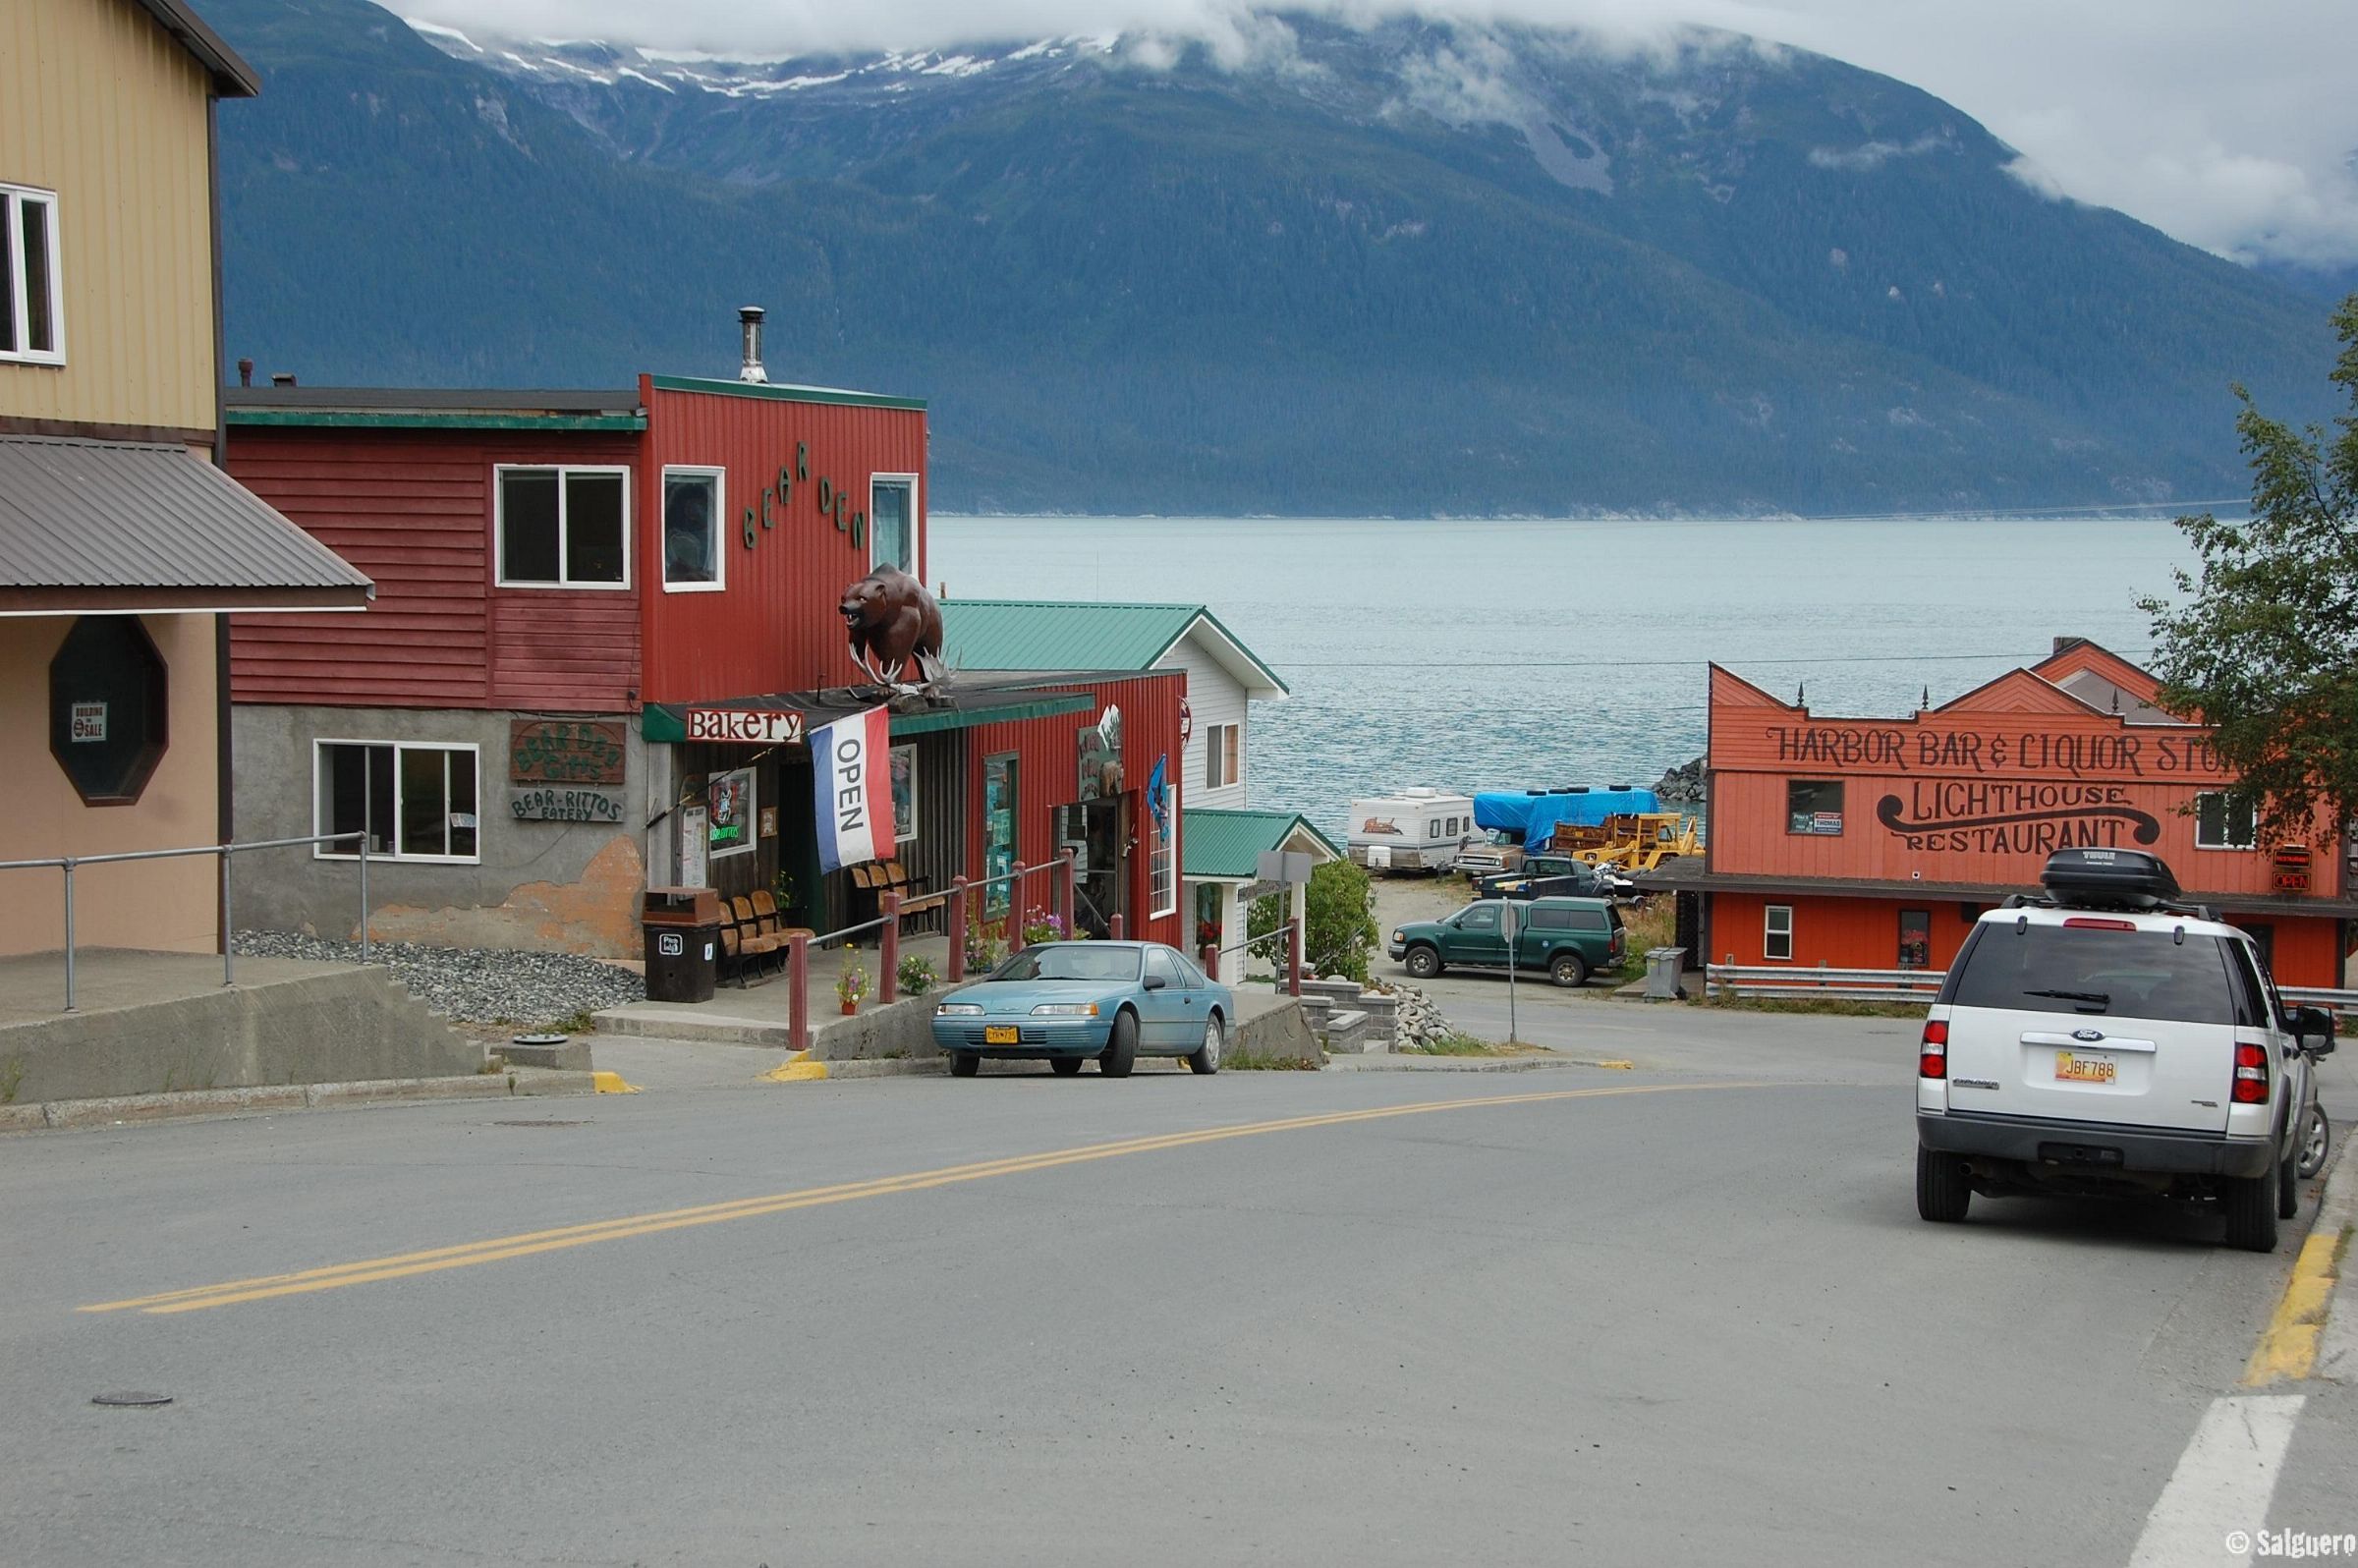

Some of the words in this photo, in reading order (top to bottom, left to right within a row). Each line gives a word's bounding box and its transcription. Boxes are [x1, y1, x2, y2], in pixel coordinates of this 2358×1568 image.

[744, 439, 810, 550] BEAR
[818, 476, 864, 550] DEN
[84, 723, 103, 737] SALE
[688, 711, 803, 744] Bakery
[1766, 727, 1909, 770] HARBOR
[1917, 730, 1986, 773] BAR
[1990, 734, 2008, 768] &
[2018, 734, 2145, 778] LIQUOR
[837, 738, 864, 832] OPEN
[1912, 780, 2134, 820] LIGHTHOUSE
[512, 789, 623, 821] BEAR-RITTOS
[541, 807, 593, 821] EATERY
[1890, 818, 2126, 855] RESTAURANT
[2274, 874, 2308, 888] OPEN
[2065, 1060, 2114, 1078] JBF788
